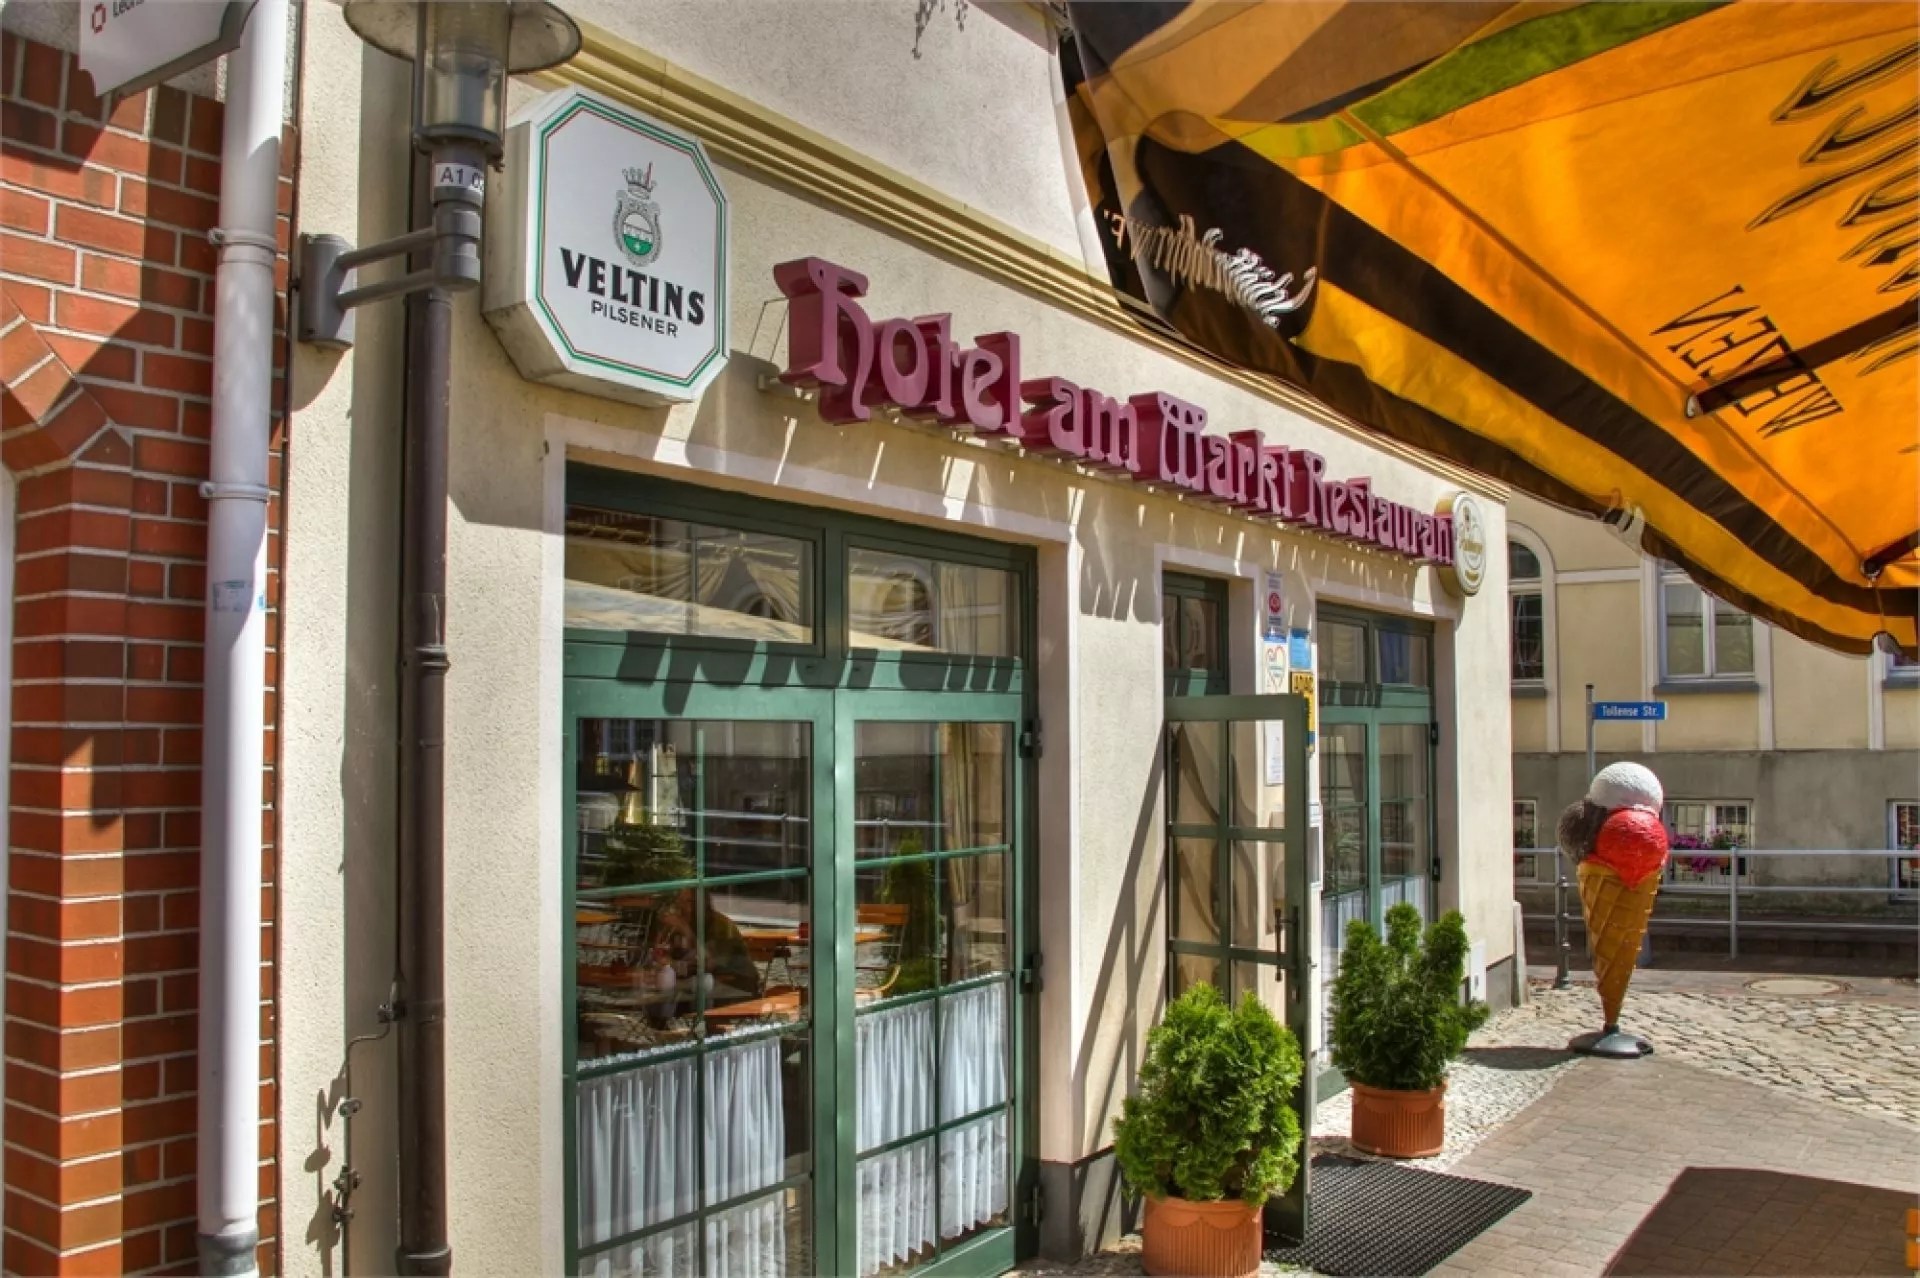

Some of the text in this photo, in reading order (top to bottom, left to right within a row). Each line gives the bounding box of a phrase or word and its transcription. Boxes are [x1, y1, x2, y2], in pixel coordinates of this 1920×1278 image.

[440, 166, 464, 185] A1
[560, 247, 705, 326] VELTINS
[591, 299, 679, 338] PILSENER
[804, 256, 1025, 437] Hotel
[1047, 376, 1141, 472] am
[1157, 391, 1295, 519] Markt
[1303, 448, 1453, 565] Restauran
[1642, 704, 1660, 717] Str.
